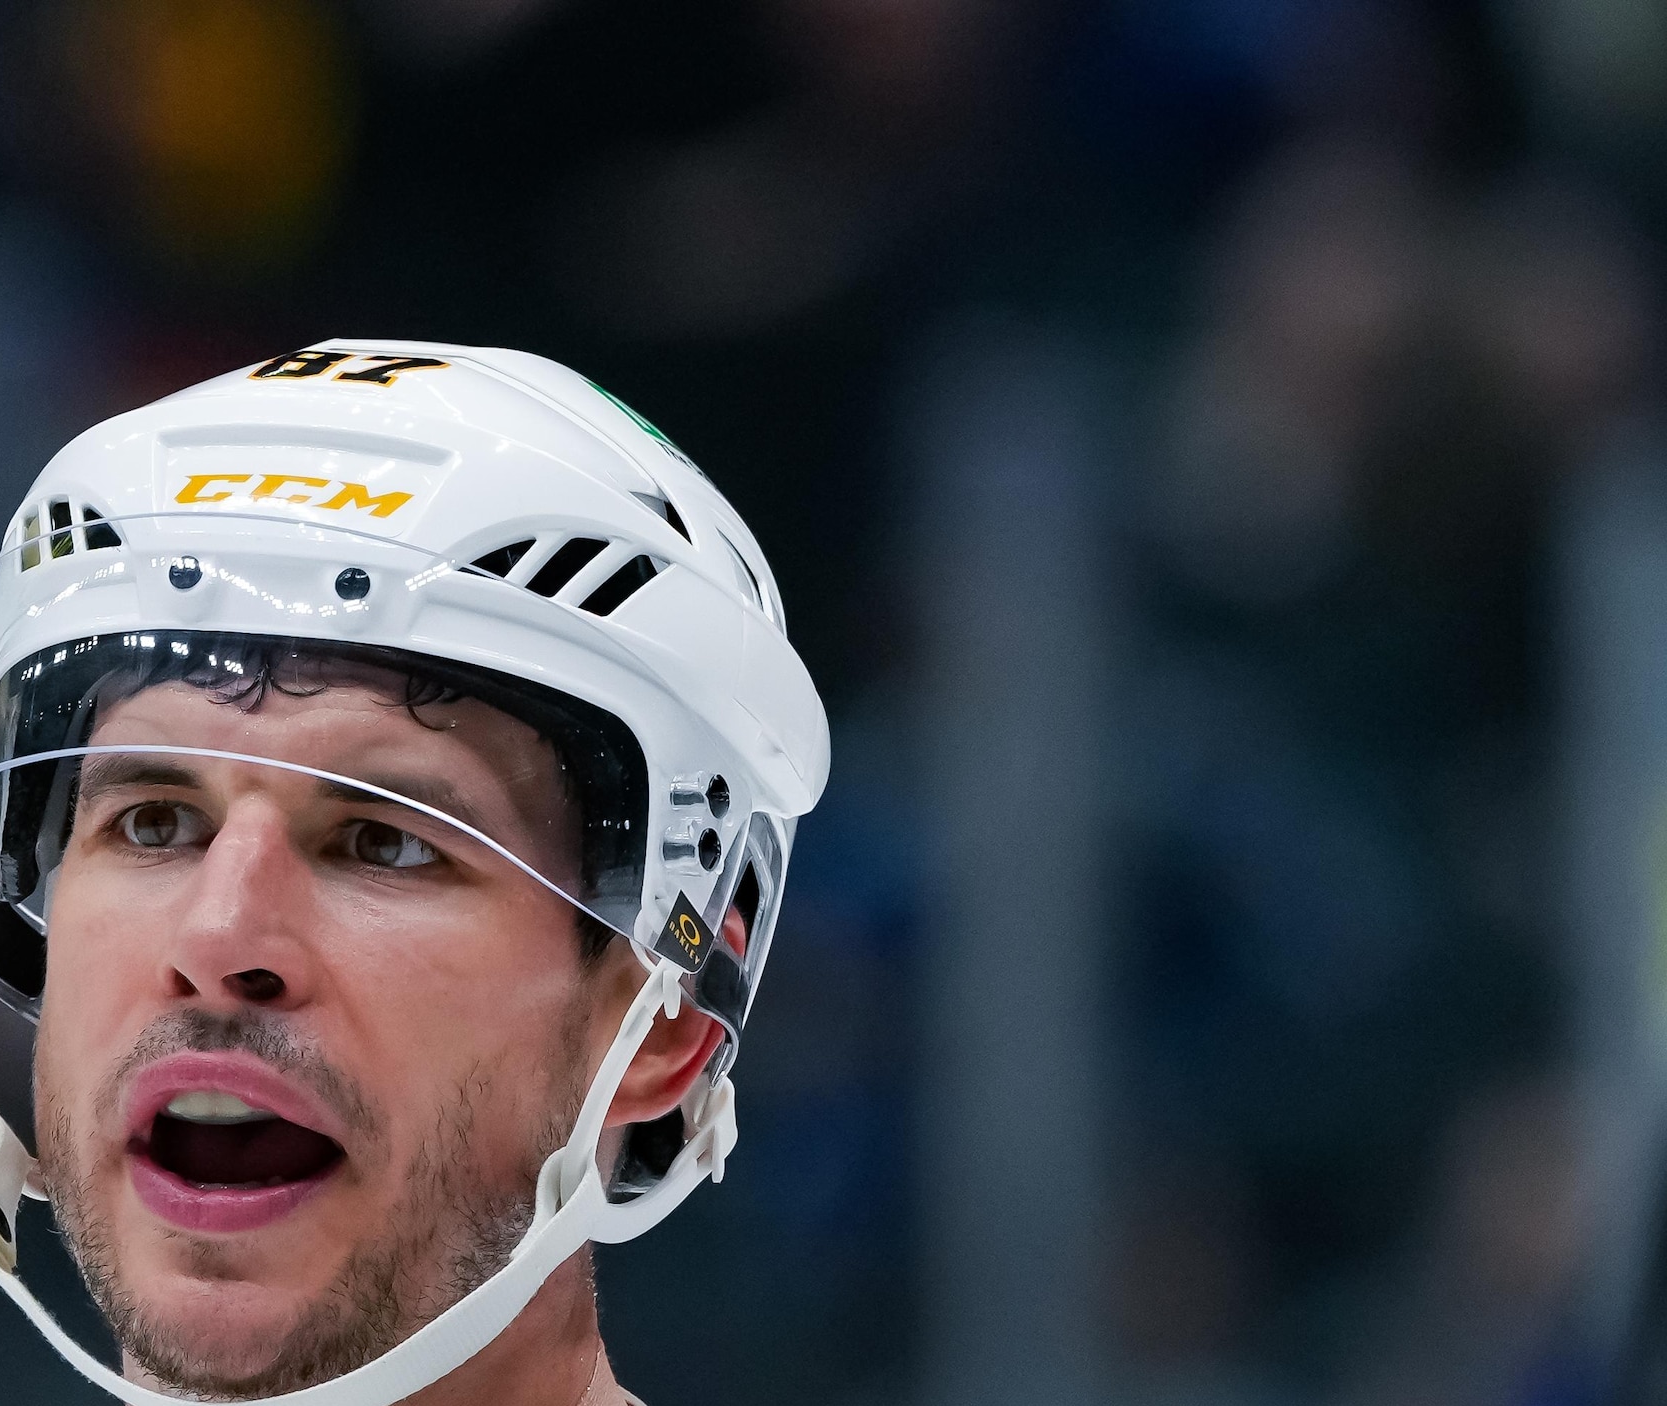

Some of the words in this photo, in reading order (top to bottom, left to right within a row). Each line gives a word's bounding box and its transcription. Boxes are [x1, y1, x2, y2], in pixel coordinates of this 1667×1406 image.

[246, 350, 452, 388] 87
[174, 473, 415, 519] CCM
[669, 921, 701, 965] OAKLEY
